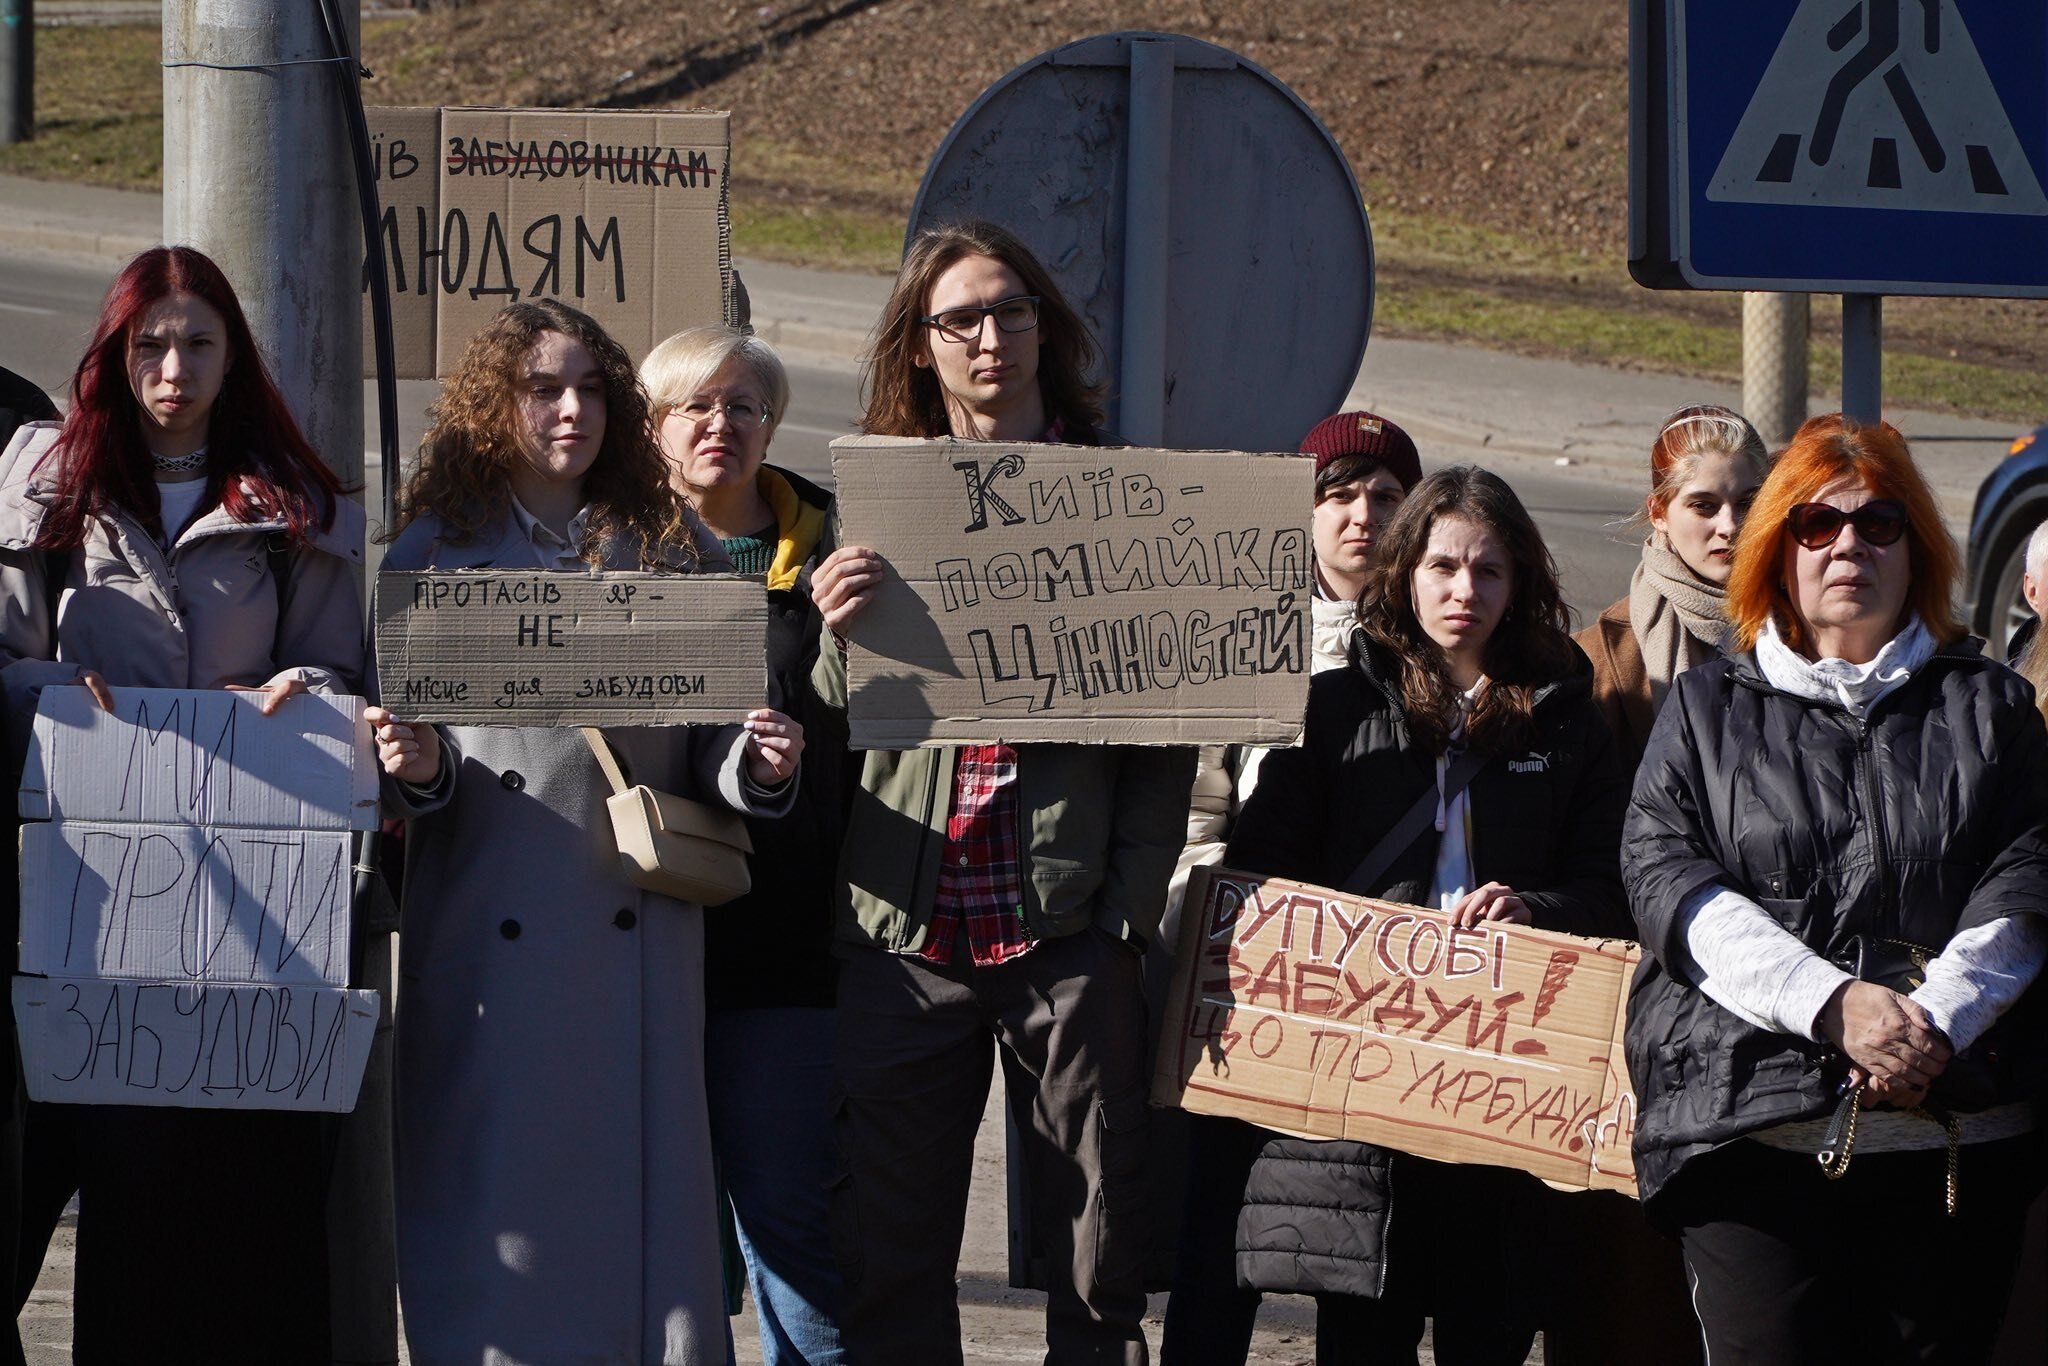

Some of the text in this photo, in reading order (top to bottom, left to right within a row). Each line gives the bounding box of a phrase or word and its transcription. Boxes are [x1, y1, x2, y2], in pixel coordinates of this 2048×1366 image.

[373, 133, 714, 188] ЇВ ЗАБУДОВНИКАМ
[362, 206, 626, 303] ЛЮДЯМ
[935, 516, 1307, 612] ПОМИЙКА
[517, 613, 565, 648] НЕ
[494, 678, 544, 708] для
[576, 674, 705, 700] ЗАБУДОВИ
[119, 697, 237, 813] МИ
[1508, 760, 1543, 773] PUMA
[64, 832, 343, 979] ПРОТИ
[52, 983, 346, 1101] ЗАБУДОВИ
[1189, 1001, 1284, 1059] ЩО
[1310, 1030, 1393, 1082] ПО
